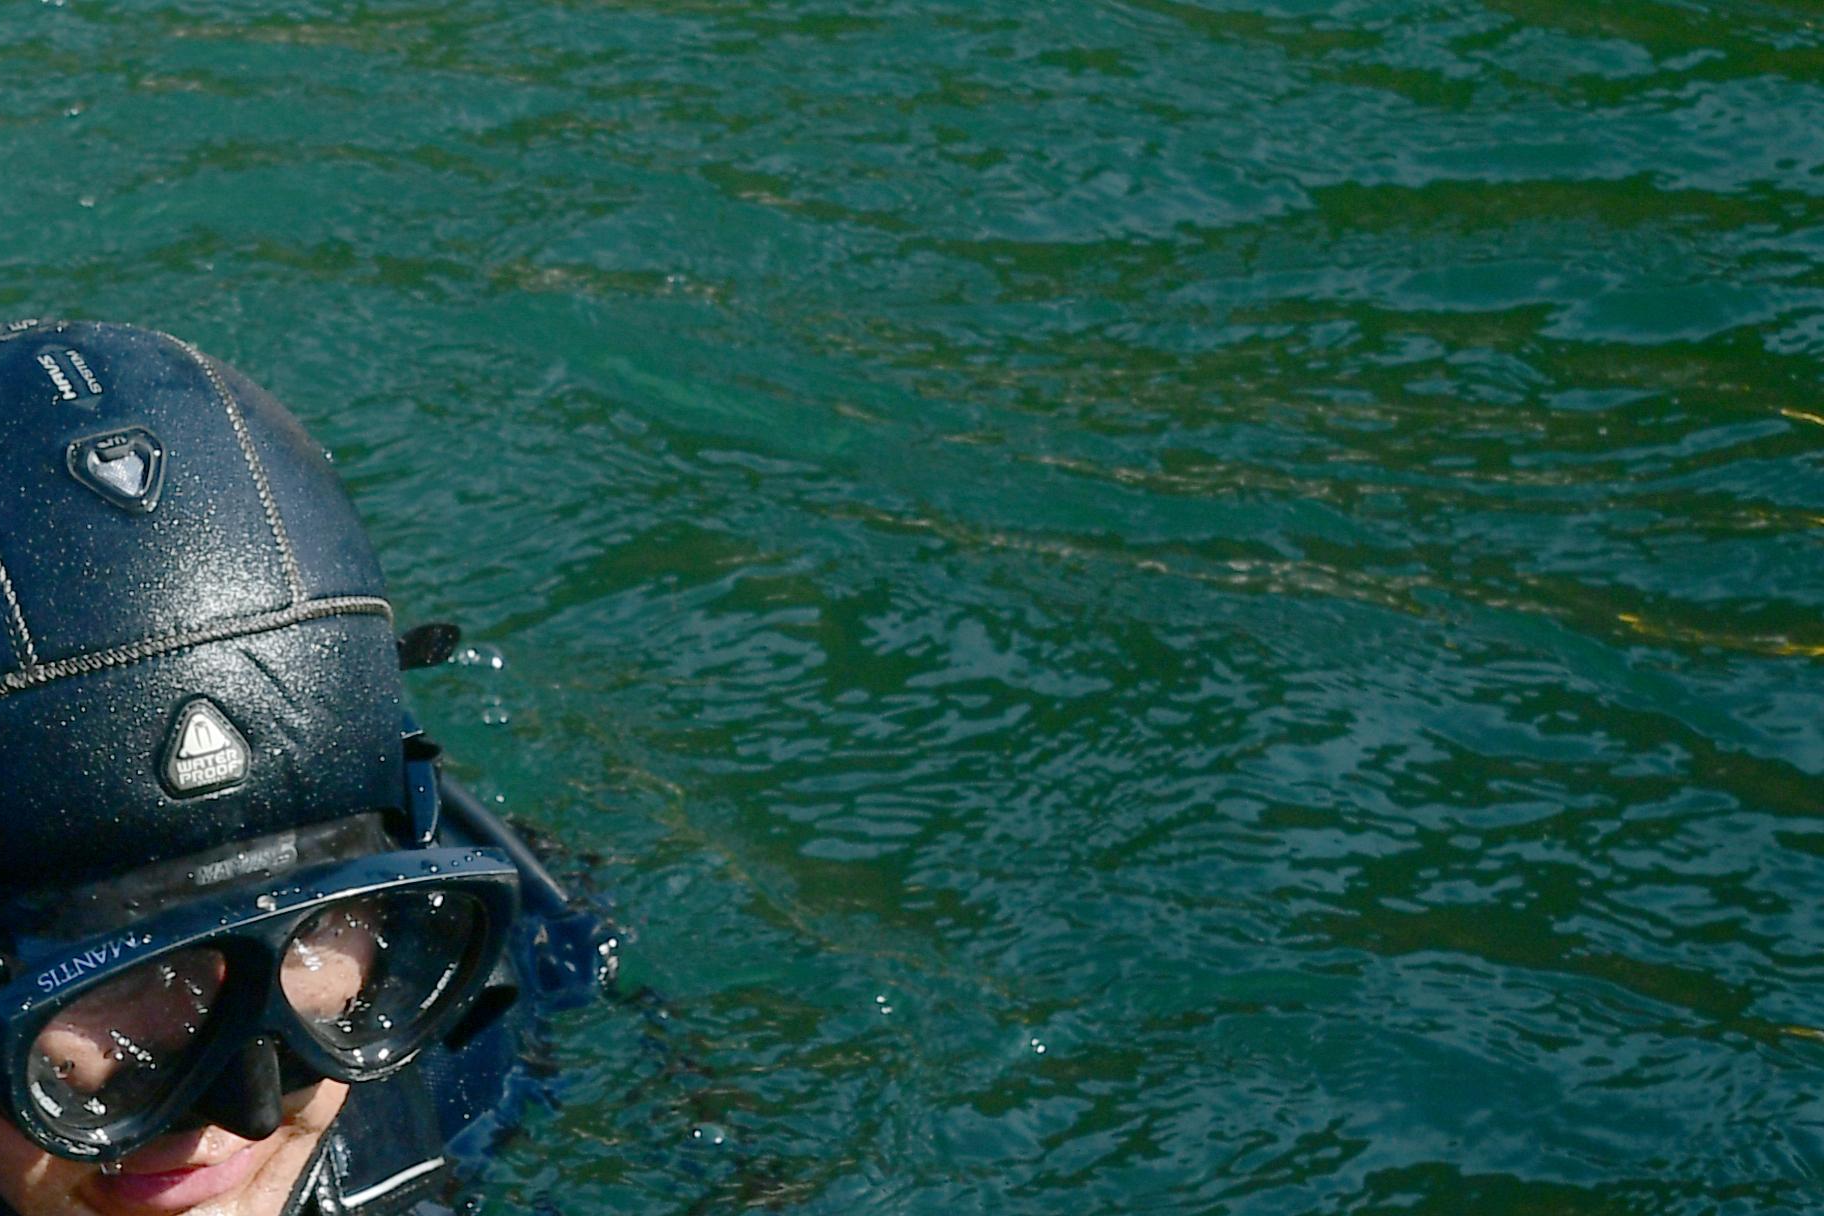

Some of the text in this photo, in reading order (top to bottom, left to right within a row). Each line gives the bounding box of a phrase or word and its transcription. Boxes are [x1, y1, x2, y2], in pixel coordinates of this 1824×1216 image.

[37, 354, 77, 400] HAVS
[65, 349, 103, 394] SYSTEM
[176, 748, 237, 774] WATER
[179, 761, 242, 785] PROOF
[37, 931, 142, 993] MANTIS
